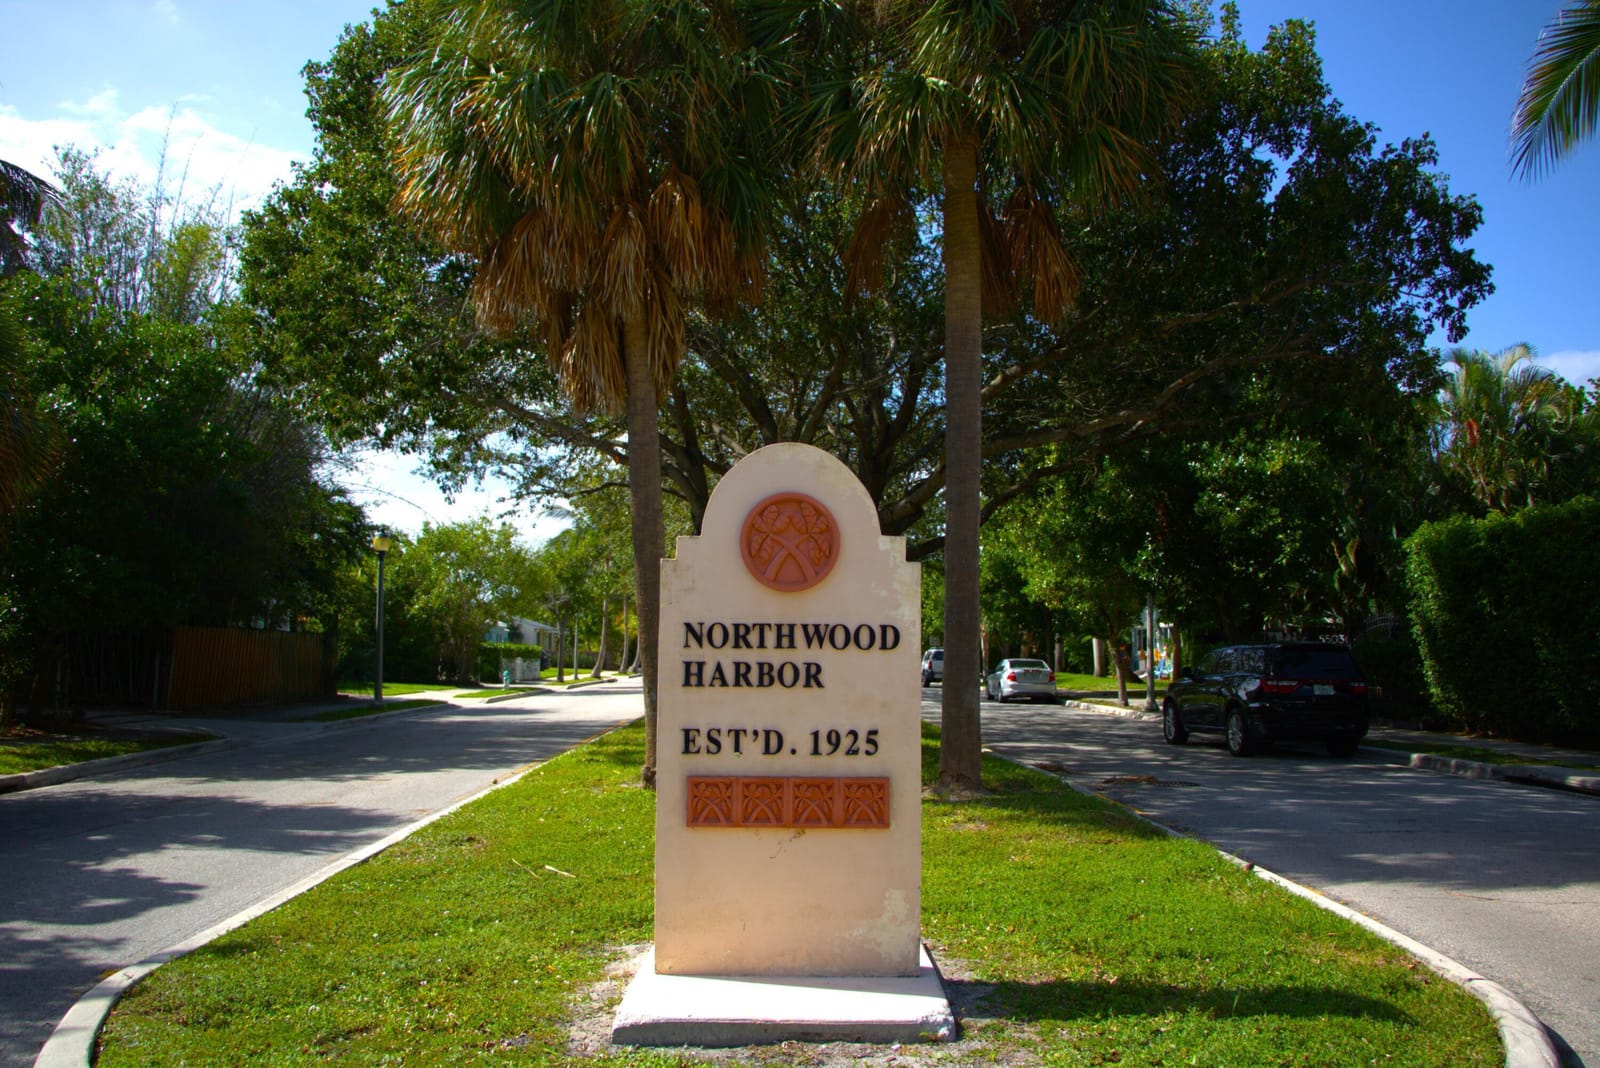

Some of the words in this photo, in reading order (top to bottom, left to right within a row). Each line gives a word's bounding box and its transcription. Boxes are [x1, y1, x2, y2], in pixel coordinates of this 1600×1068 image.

[682, 621, 901, 651] NORTHWOOD
[682, 660, 825, 689] HARBOR
[809, 727, 879, 757] 1925
